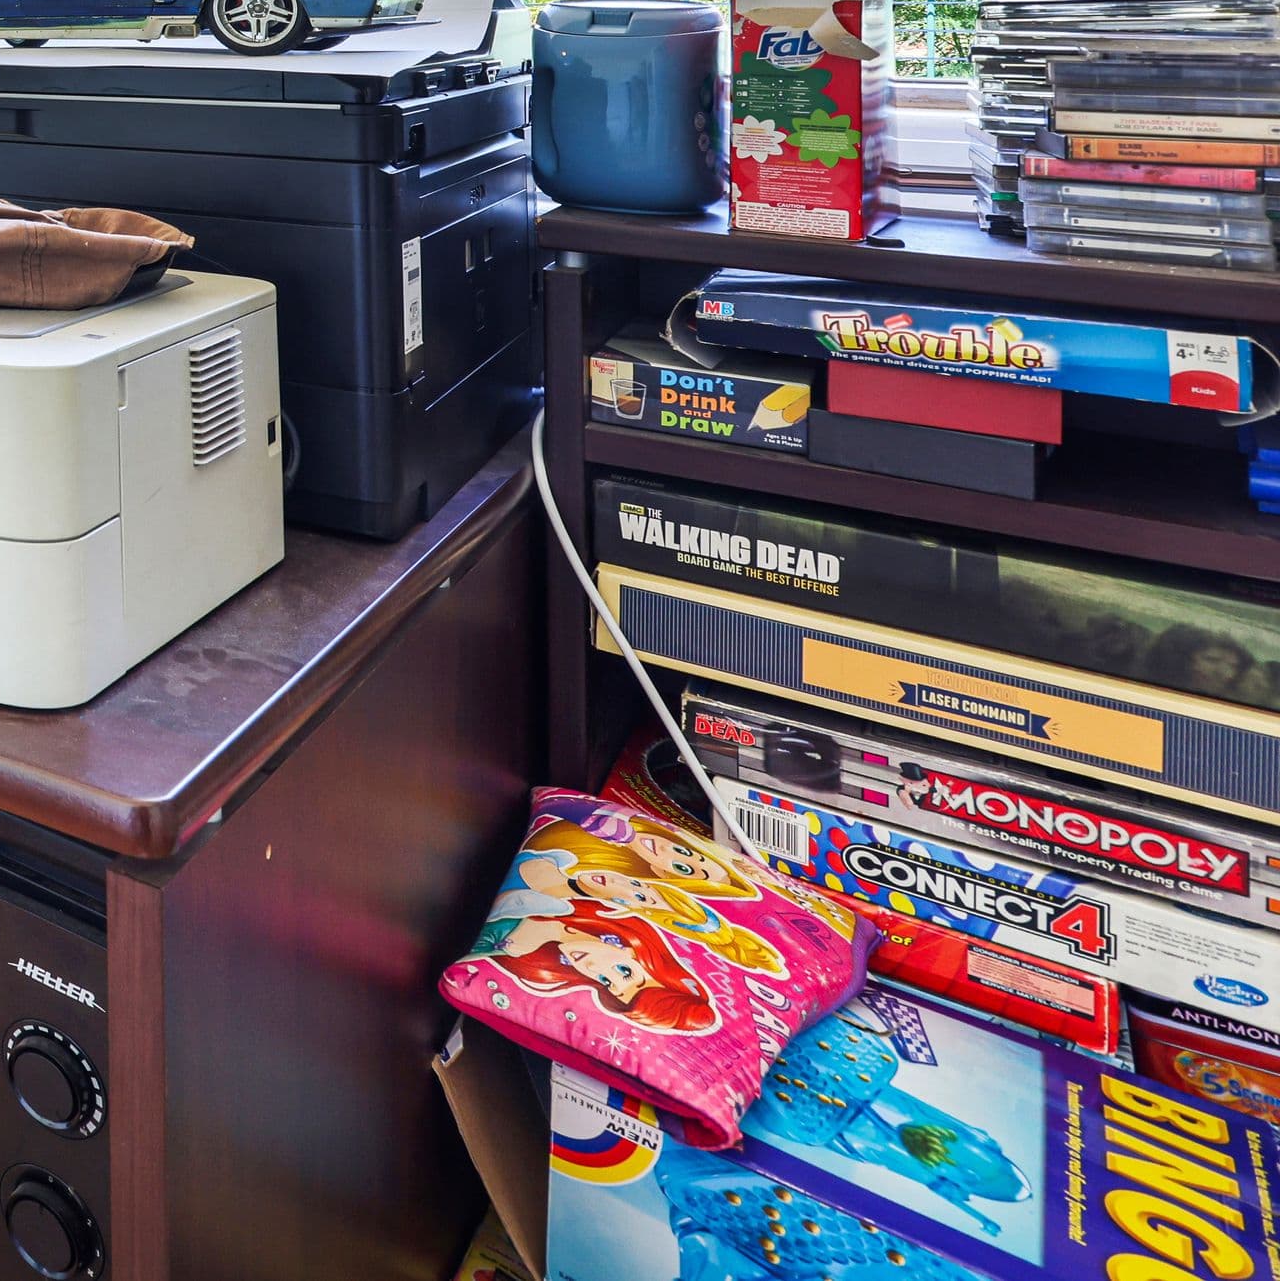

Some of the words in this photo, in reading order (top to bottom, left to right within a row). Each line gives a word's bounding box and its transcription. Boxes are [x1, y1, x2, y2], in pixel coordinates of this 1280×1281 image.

[704, 300, 735, 316] MB
[823, 314, 1048, 369] Trouble
[660, 369, 735, 396] Don't
[965, 367, 1017, 380] POPPING
[1020, 374, 1052, 384] MAD!
[660, 387, 737, 415] Drink
[683, 409, 713, 419] and
[660, 410, 734, 437] Draw
[647, 507, 662, 519] THE
[619, 512, 751, 566] WALKING
[756, 539, 840, 584] DEAD
[677, 553, 711, 568] BOARD
[713, 560, 742, 576] GAME
[745, 566, 763, 580] THE
[766, 571, 791, 586] BEST
[793, 577, 840, 597] DEFENSE
[922, 690, 959, 711] LASER
[962, 699, 1026, 726] COMMAND
[695, 716, 756, 746] DEAD
[932, 778, 1239, 881] MONOPOLY
[942, 818, 966, 831] The
[968, 823, 1050, 854] Fast-Dealing
[1053, 845, 1116, 873] Property
[1119, 864, 1175, 888] Trading
[1178, 881, 1225, 900] Game
[906, 852, 982, 879] ORIGINAL
[988, 876, 1030, 894] GAME
[1036, 892, 1056, 901] OF
[849, 847, 1056, 931] CONNECT
[1050, 903, 1107, 955] 4
[8, 957, 106, 1012] HELLER
[1202, 1072, 1225, 1095] 5
[564, 1094, 659, 1141] ENTERTAINMENT
[606, 1122, 658, 1151] NEW
